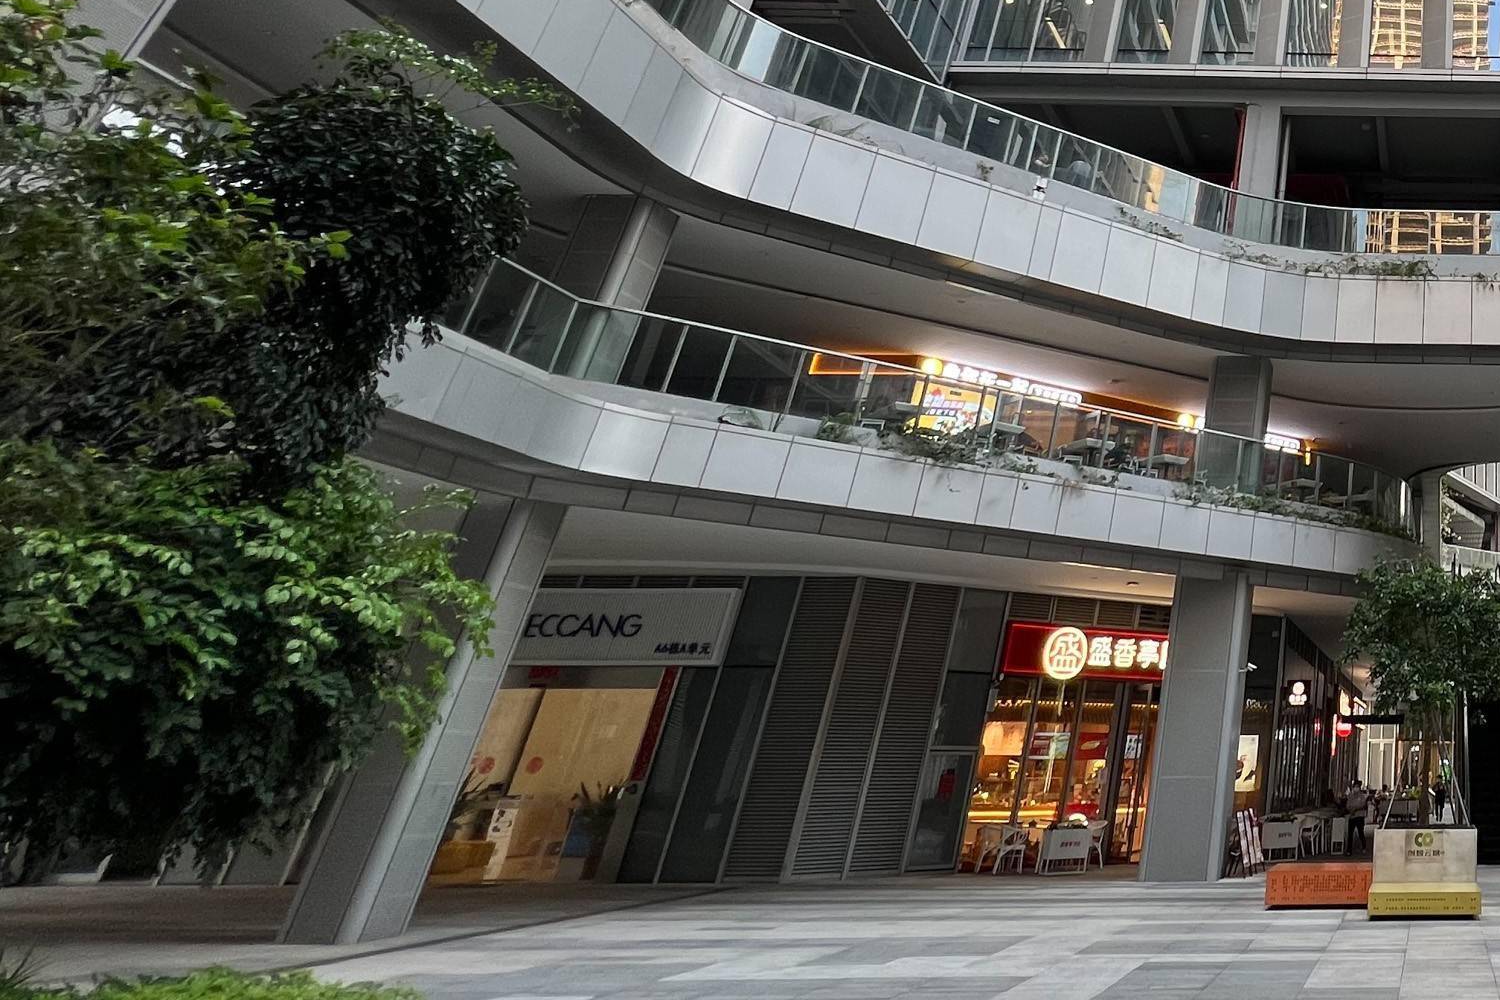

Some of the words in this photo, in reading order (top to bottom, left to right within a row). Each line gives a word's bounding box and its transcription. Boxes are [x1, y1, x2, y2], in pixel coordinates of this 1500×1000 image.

[523, 613, 643, 639] ECCANG
[1087, 636, 1169, 670] 盛香亭
